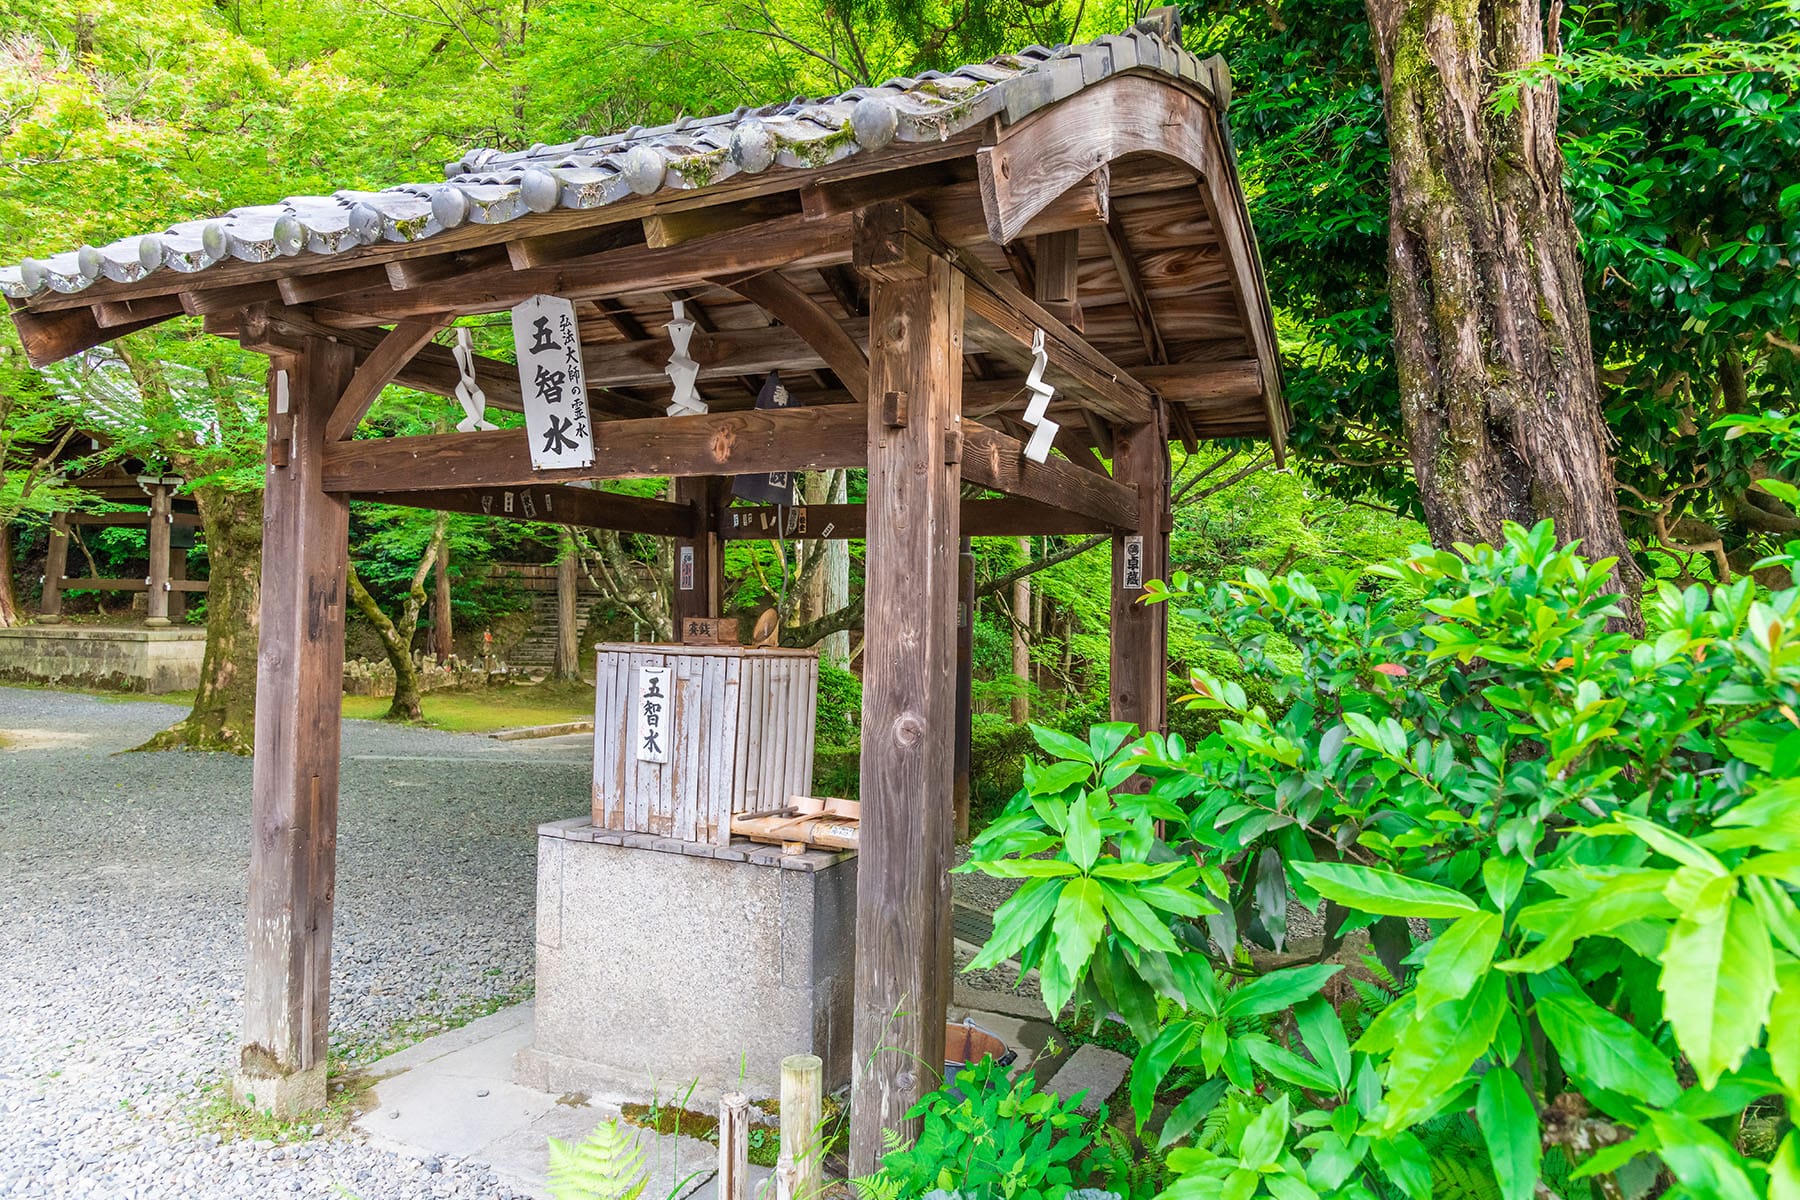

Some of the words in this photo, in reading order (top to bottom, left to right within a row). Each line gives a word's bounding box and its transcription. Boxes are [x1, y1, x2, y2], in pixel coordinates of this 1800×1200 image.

[529, 315, 579, 456] 五智水
[559, 314, 589, 439] 弘法大師の霊水
[643, 677, 664, 754] 五智水
